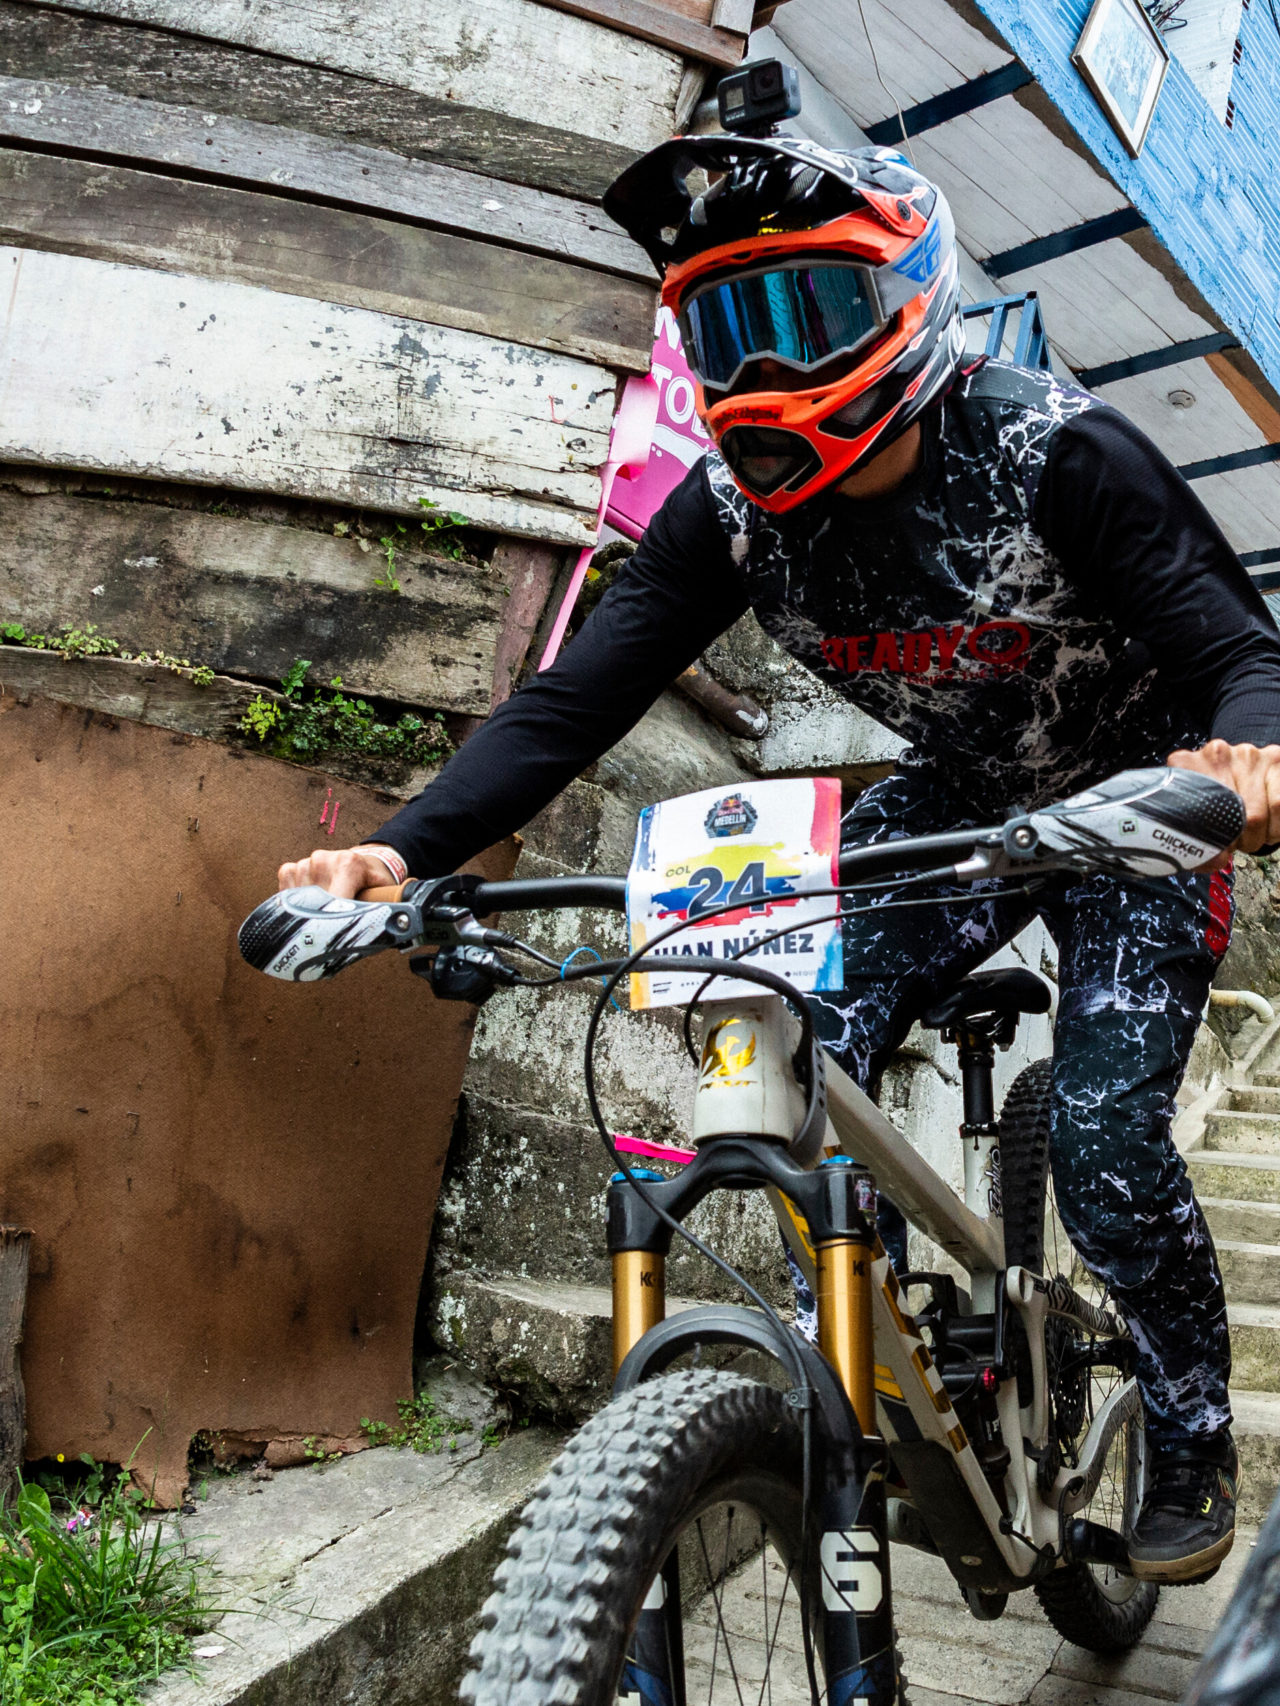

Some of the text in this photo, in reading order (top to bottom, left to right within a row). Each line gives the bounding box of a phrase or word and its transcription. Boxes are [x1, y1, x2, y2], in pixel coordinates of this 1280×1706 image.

[820, 626, 965, 673] READY
[1152, 829, 1205, 858] CHICKEN
[665, 865, 691, 878] COL
[688, 861, 771, 918] 24
